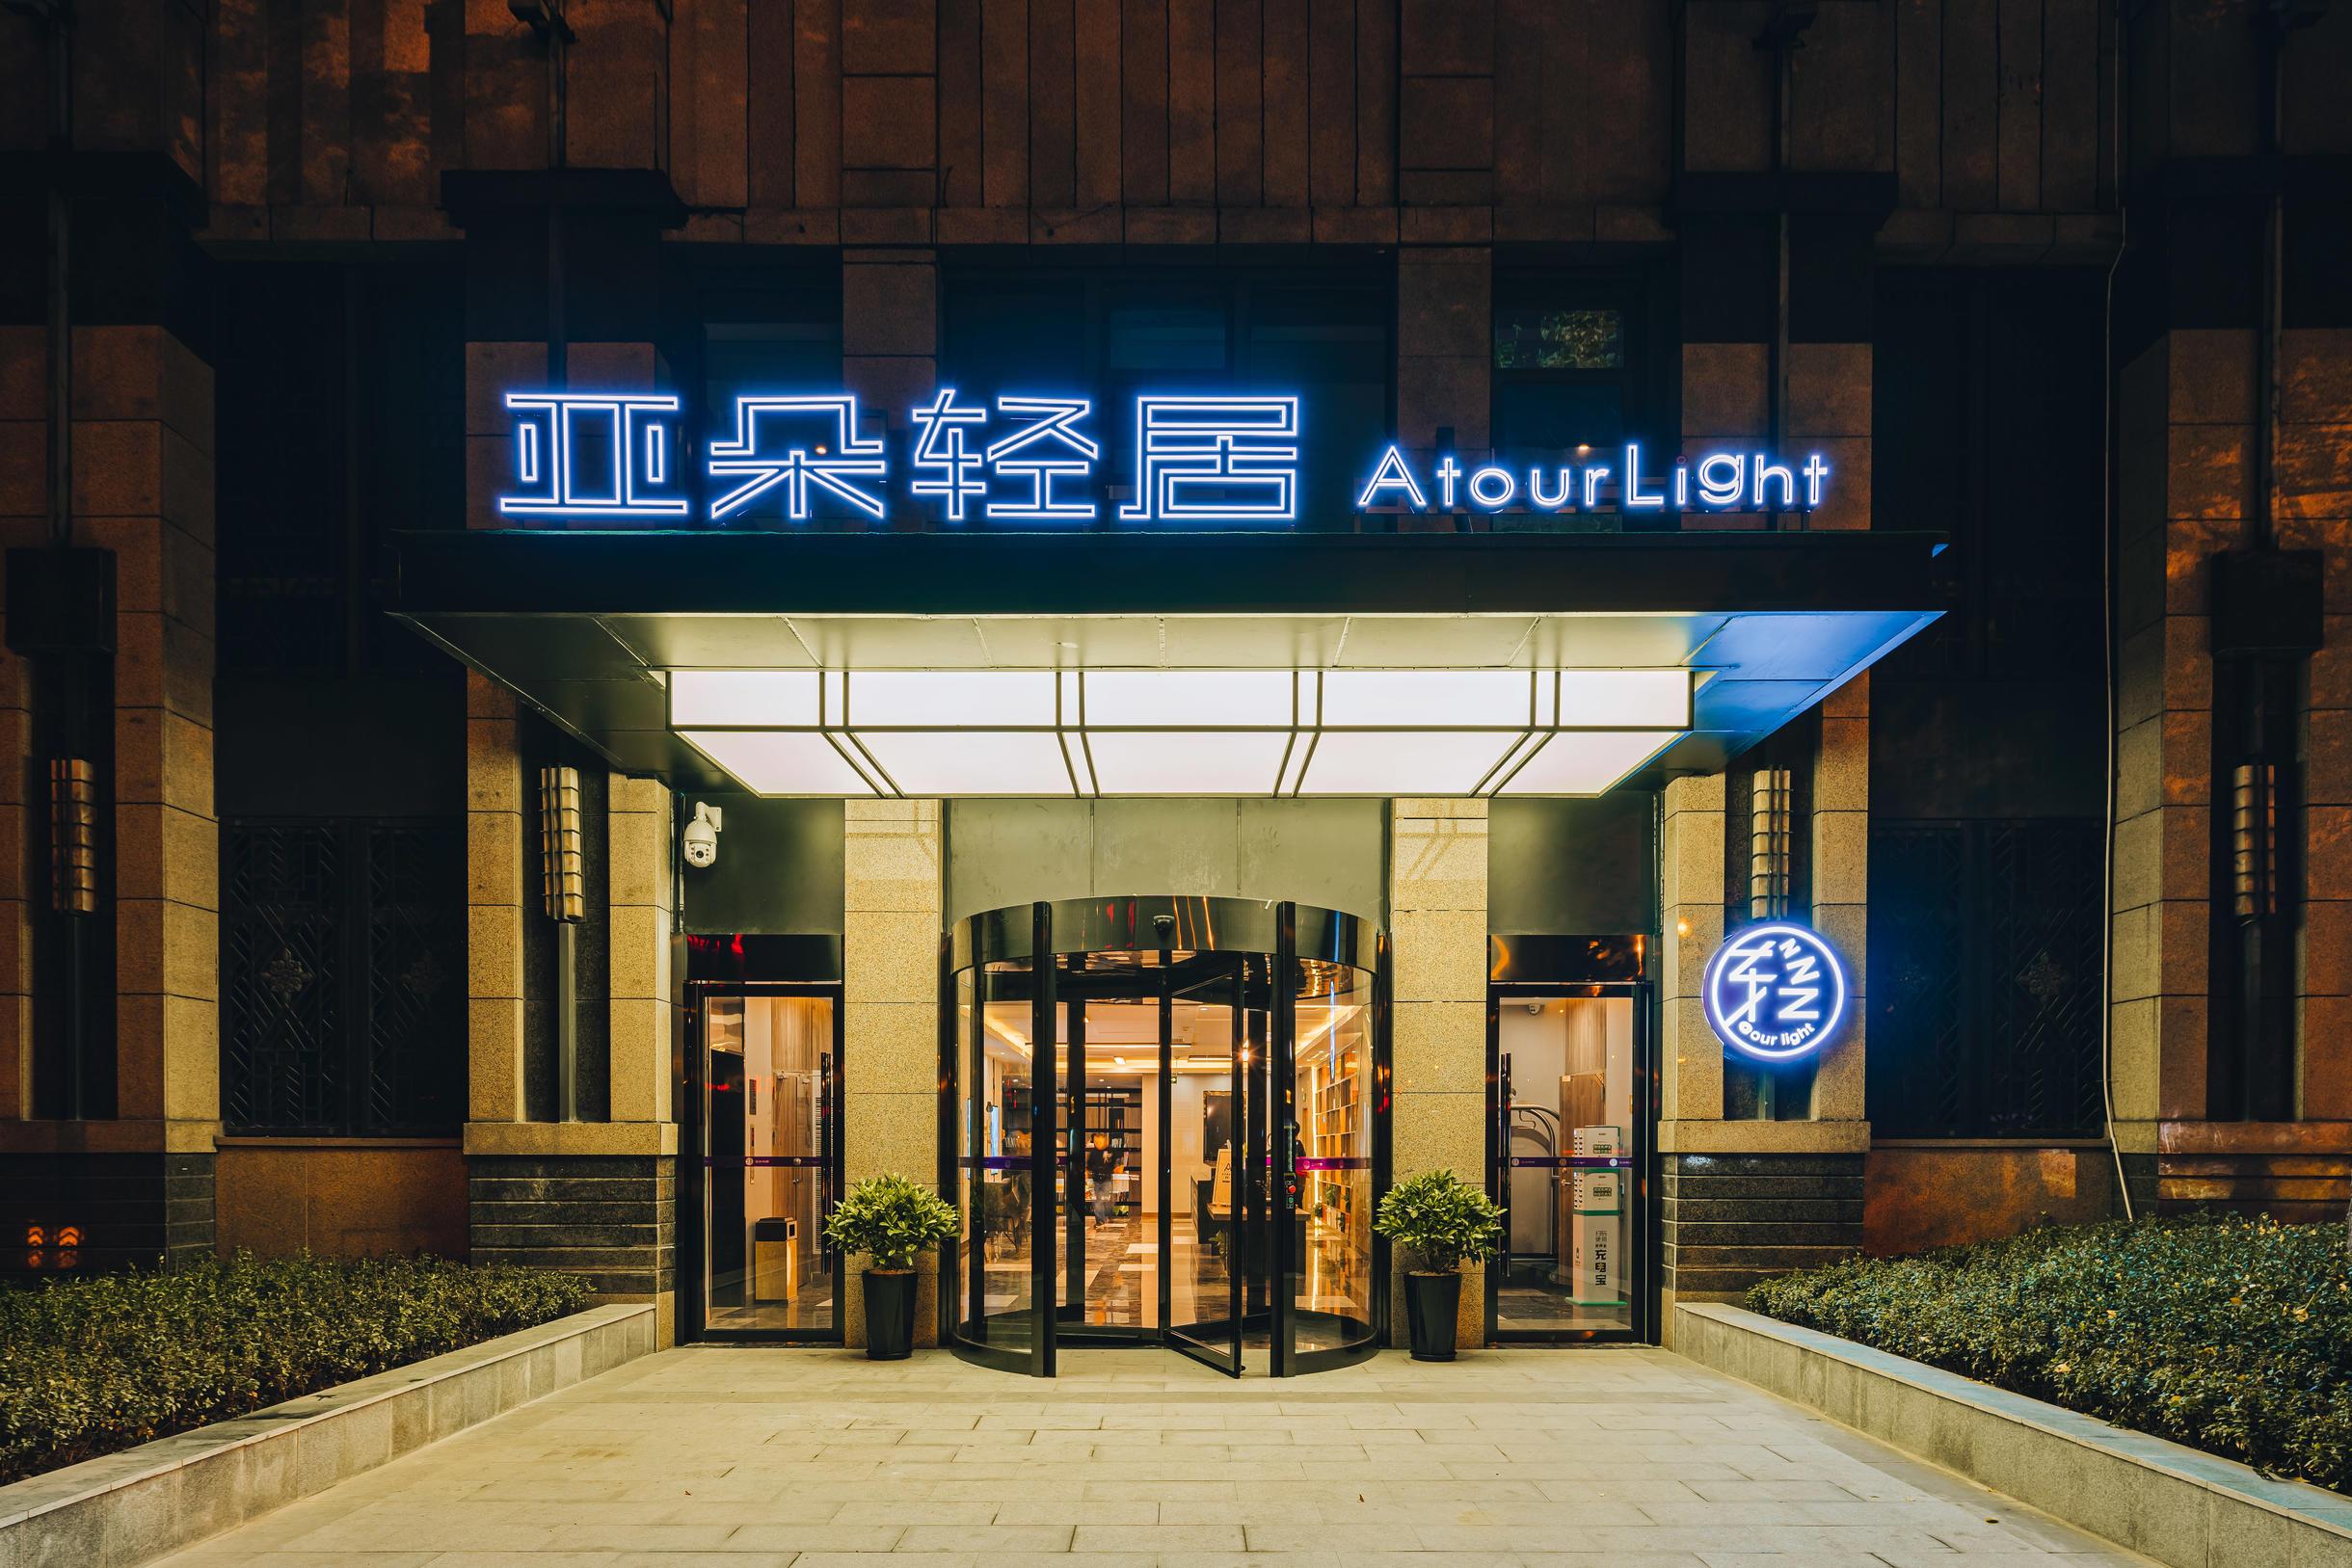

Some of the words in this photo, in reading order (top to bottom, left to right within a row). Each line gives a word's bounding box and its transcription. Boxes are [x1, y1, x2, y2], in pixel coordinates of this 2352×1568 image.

[500, 388, 1298, 520] 亚朵轻居
[1780, 1023, 1815, 1046] light
